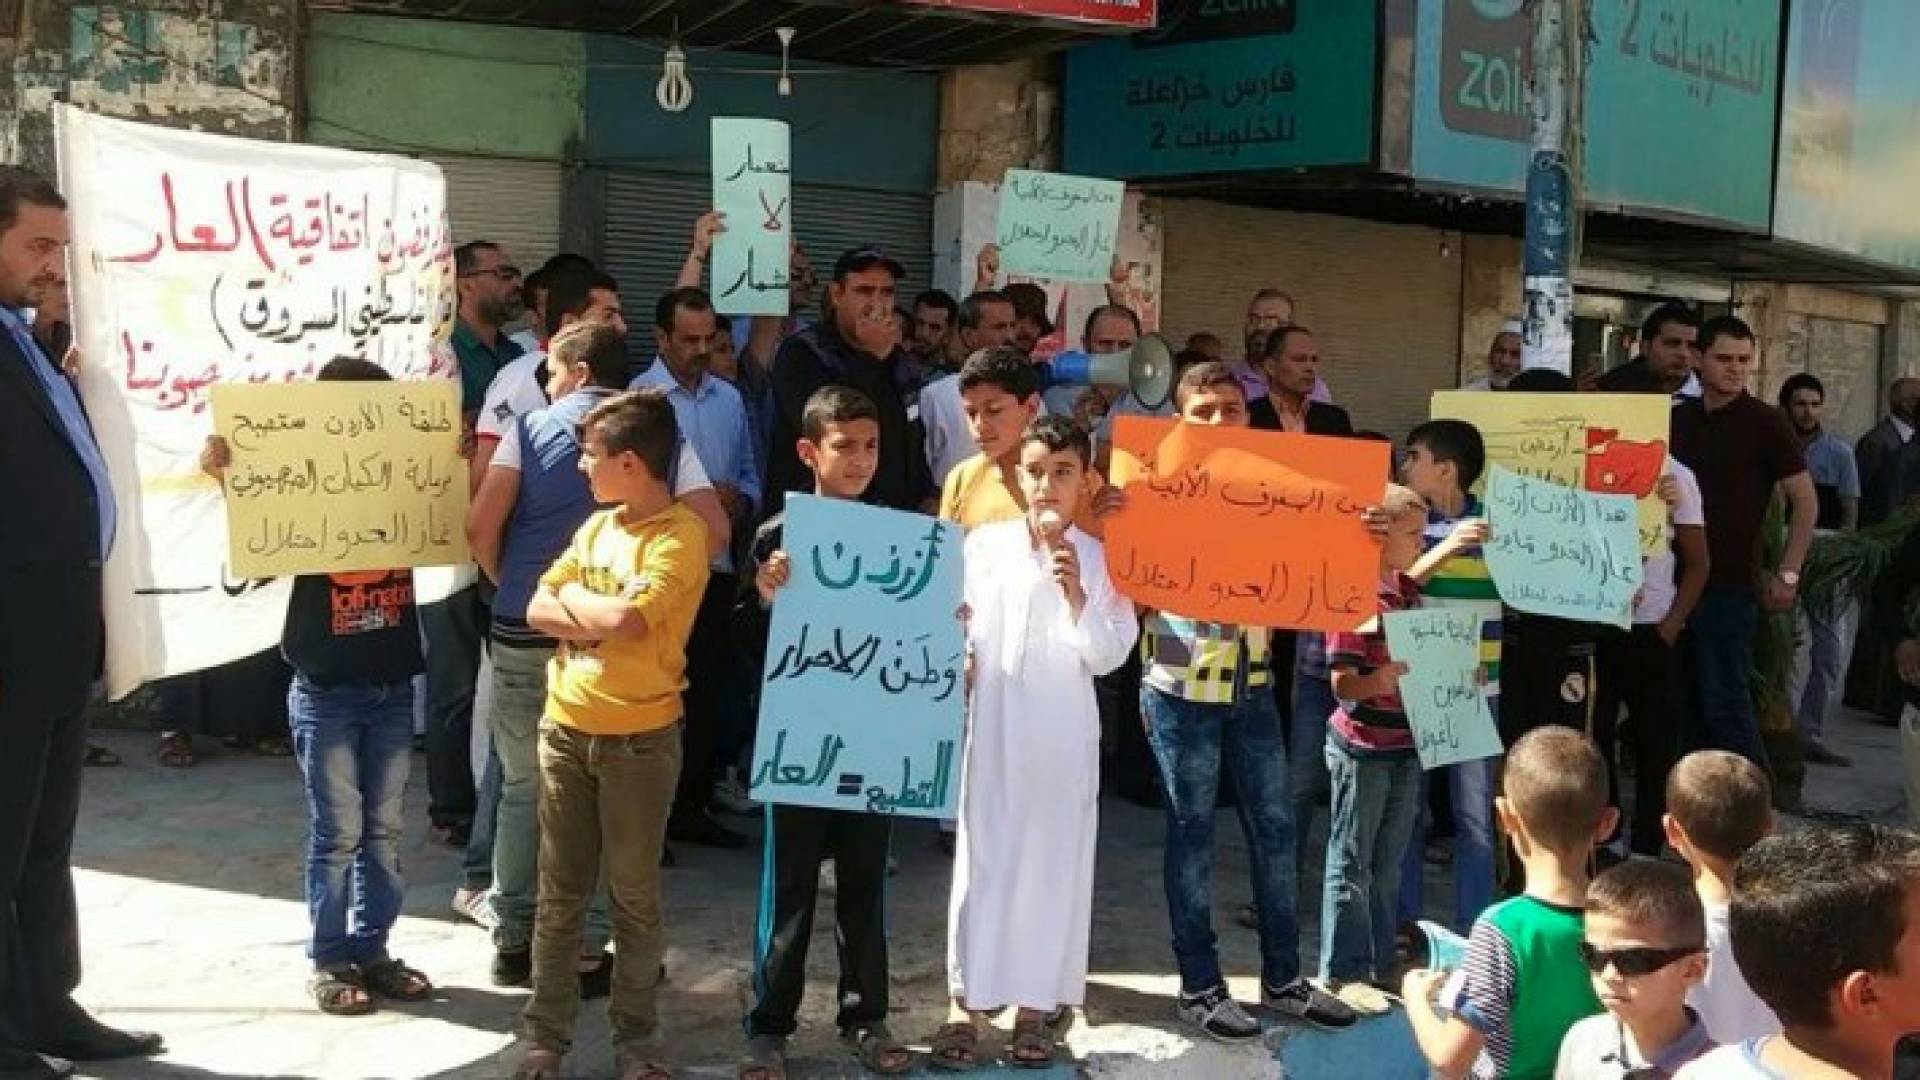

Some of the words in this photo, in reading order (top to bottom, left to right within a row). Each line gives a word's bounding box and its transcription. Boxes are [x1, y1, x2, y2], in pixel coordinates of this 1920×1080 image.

[1619, 0, 1641, 56] 2
[1457, 47, 1522, 117] zai
[1650, 10, 1765, 107] للخلويات
[1127, 75, 1211, 111] خزاعلة
[1221, 63, 1296, 108] فارس
[1151, 120, 1168, 150] 2
[1176, 113, 1295, 155] للخلويات
[106, 172, 275, 273] العار
[269, 190, 368, 266] اتفاقية
[759, 188, 787, 230] لا
[232, 412, 307, 451] ستصبح
[231, 457, 318, 498] الصهيوني
[322, 450, 393, 495] الكيان
[248, 511, 328, 557] احتلال
[334, 511, 409, 560] العدو
[410, 502, 450, 554] غاز
[1117, 547, 1197, 594] احتلال
[1209, 561, 1289, 608] العدو
[1295, 560, 1363, 624] غاز
[751, 729, 845, 789] العار
[866, 740, 953, 812] التطبيع
